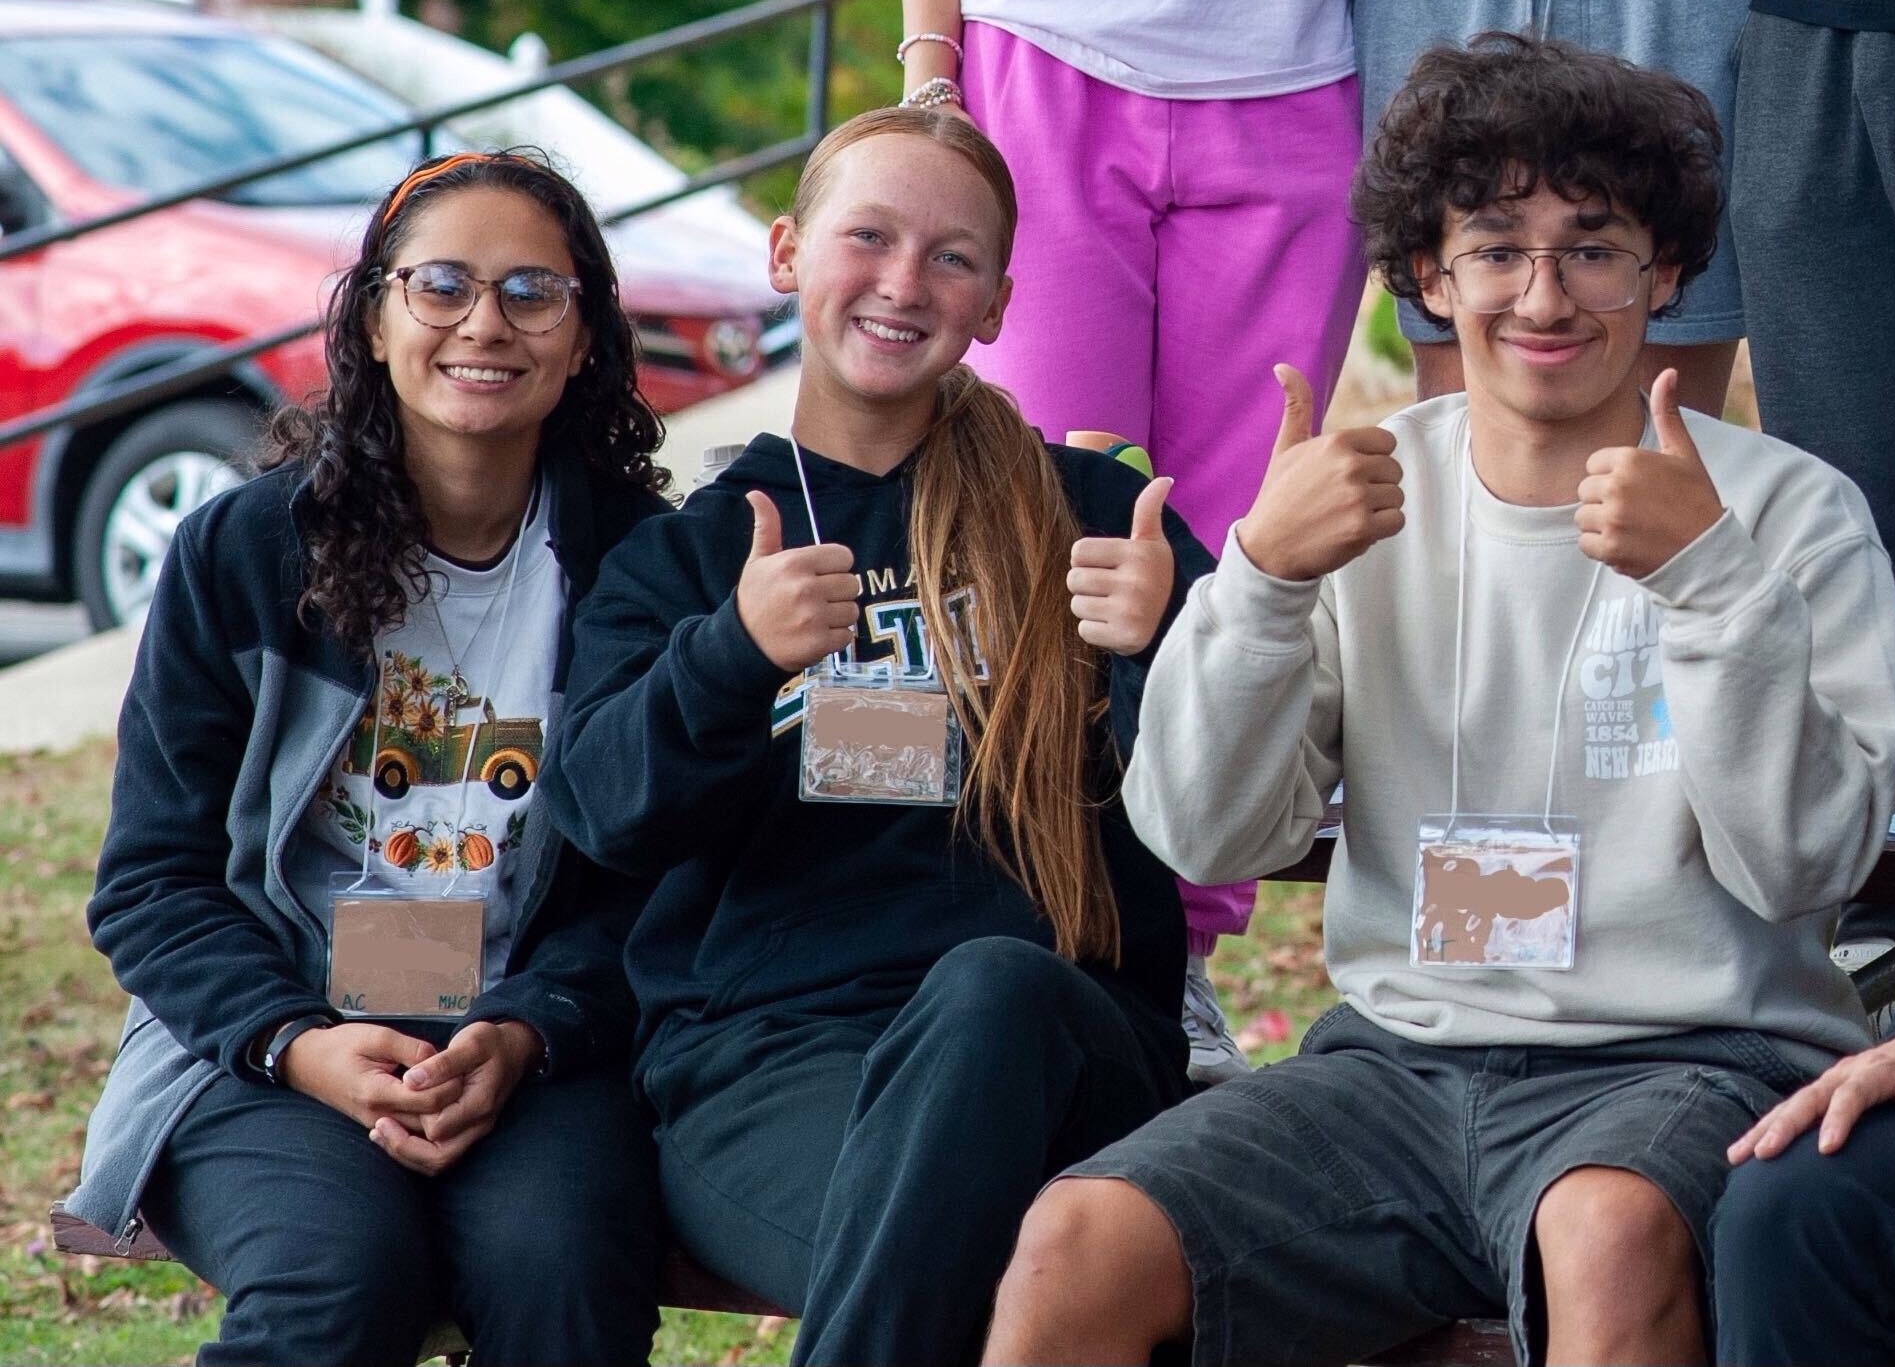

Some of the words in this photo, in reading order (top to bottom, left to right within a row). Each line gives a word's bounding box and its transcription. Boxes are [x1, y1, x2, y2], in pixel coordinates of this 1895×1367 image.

[1585, 701, 1615, 712] CATCH
[1616, 700, 1633, 712] THE
[1586, 712, 1634, 723] WAVES
[1585, 723, 1640, 744] 1854
[1585, 745, 1630, 779] NEW
[342, 994, 366, 1011] AC
